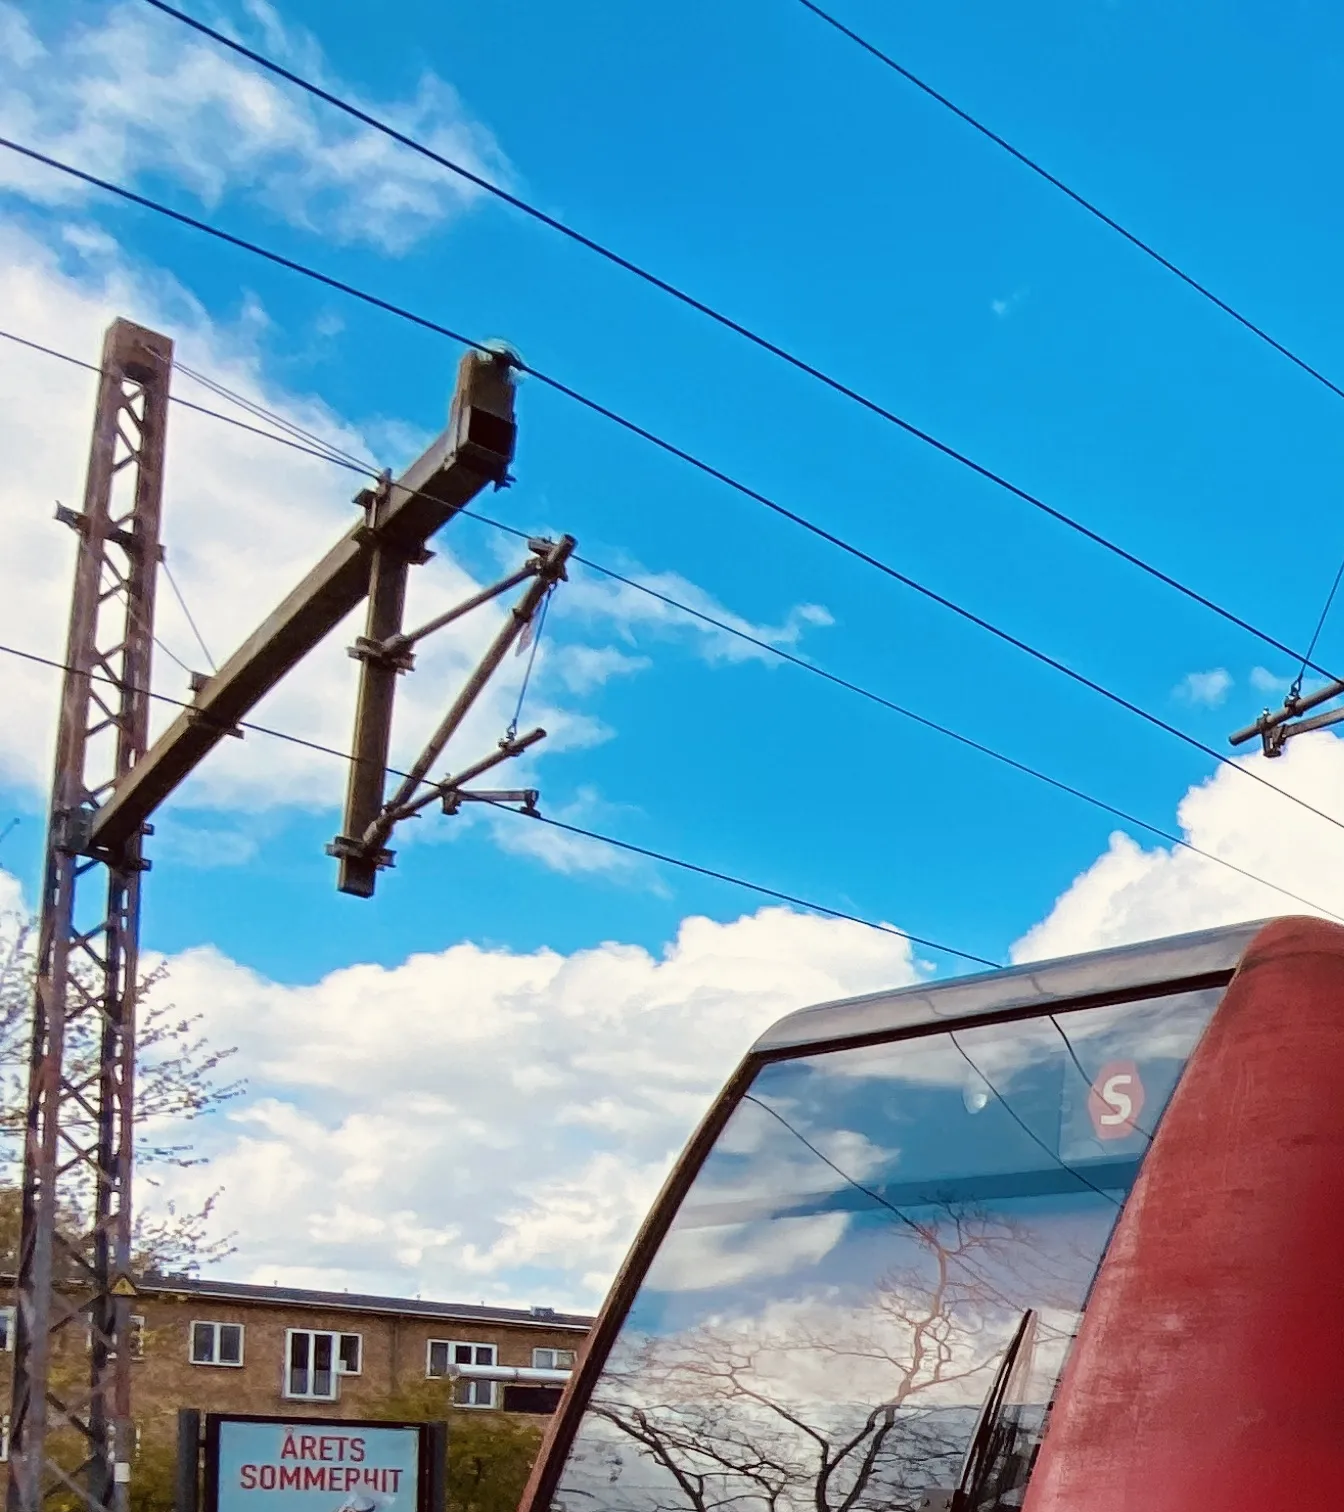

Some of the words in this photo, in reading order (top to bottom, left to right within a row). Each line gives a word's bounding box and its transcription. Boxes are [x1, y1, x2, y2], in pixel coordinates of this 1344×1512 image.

[1100, 1074, 1132, 1125] S
[280, 1426, 366, 1462] ÅRETS
[239, 1464, 404, 1493] SOMMERHIT
